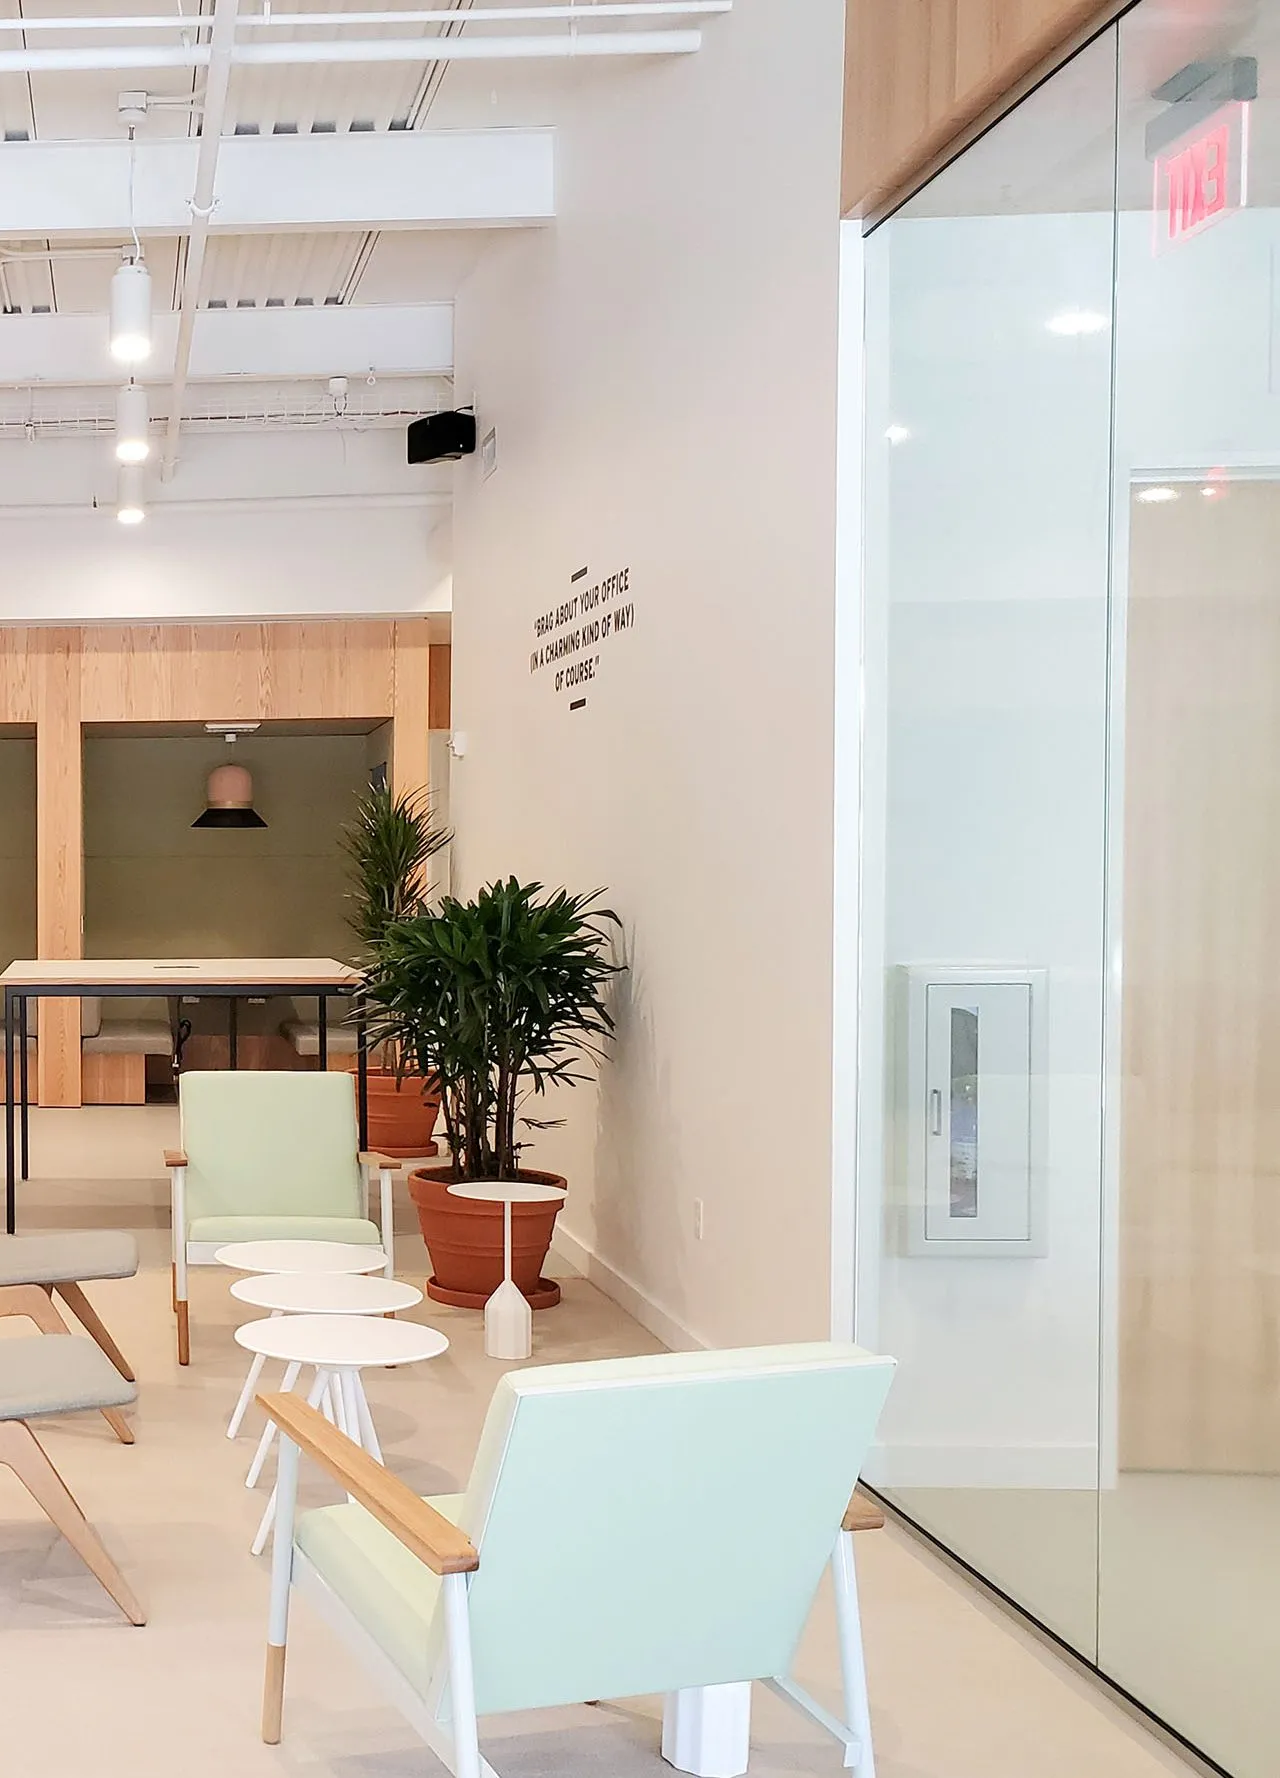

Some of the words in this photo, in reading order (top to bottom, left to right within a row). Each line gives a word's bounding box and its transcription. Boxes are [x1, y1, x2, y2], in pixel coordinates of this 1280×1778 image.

[555, 597, 578, 628] ABOUT
[580, 585, 599, 614] YOUR
[601, 567, 629, 603] OFFICE
[539, 648, 545, 666] A
[545, 630, 580, 664] CHARMING
[581, 621, 599, 648] KIND
[601, 613, 612, 638] OF
[613, 602, 635, 632] WAY)
[555, 670, 564, 692] OF
